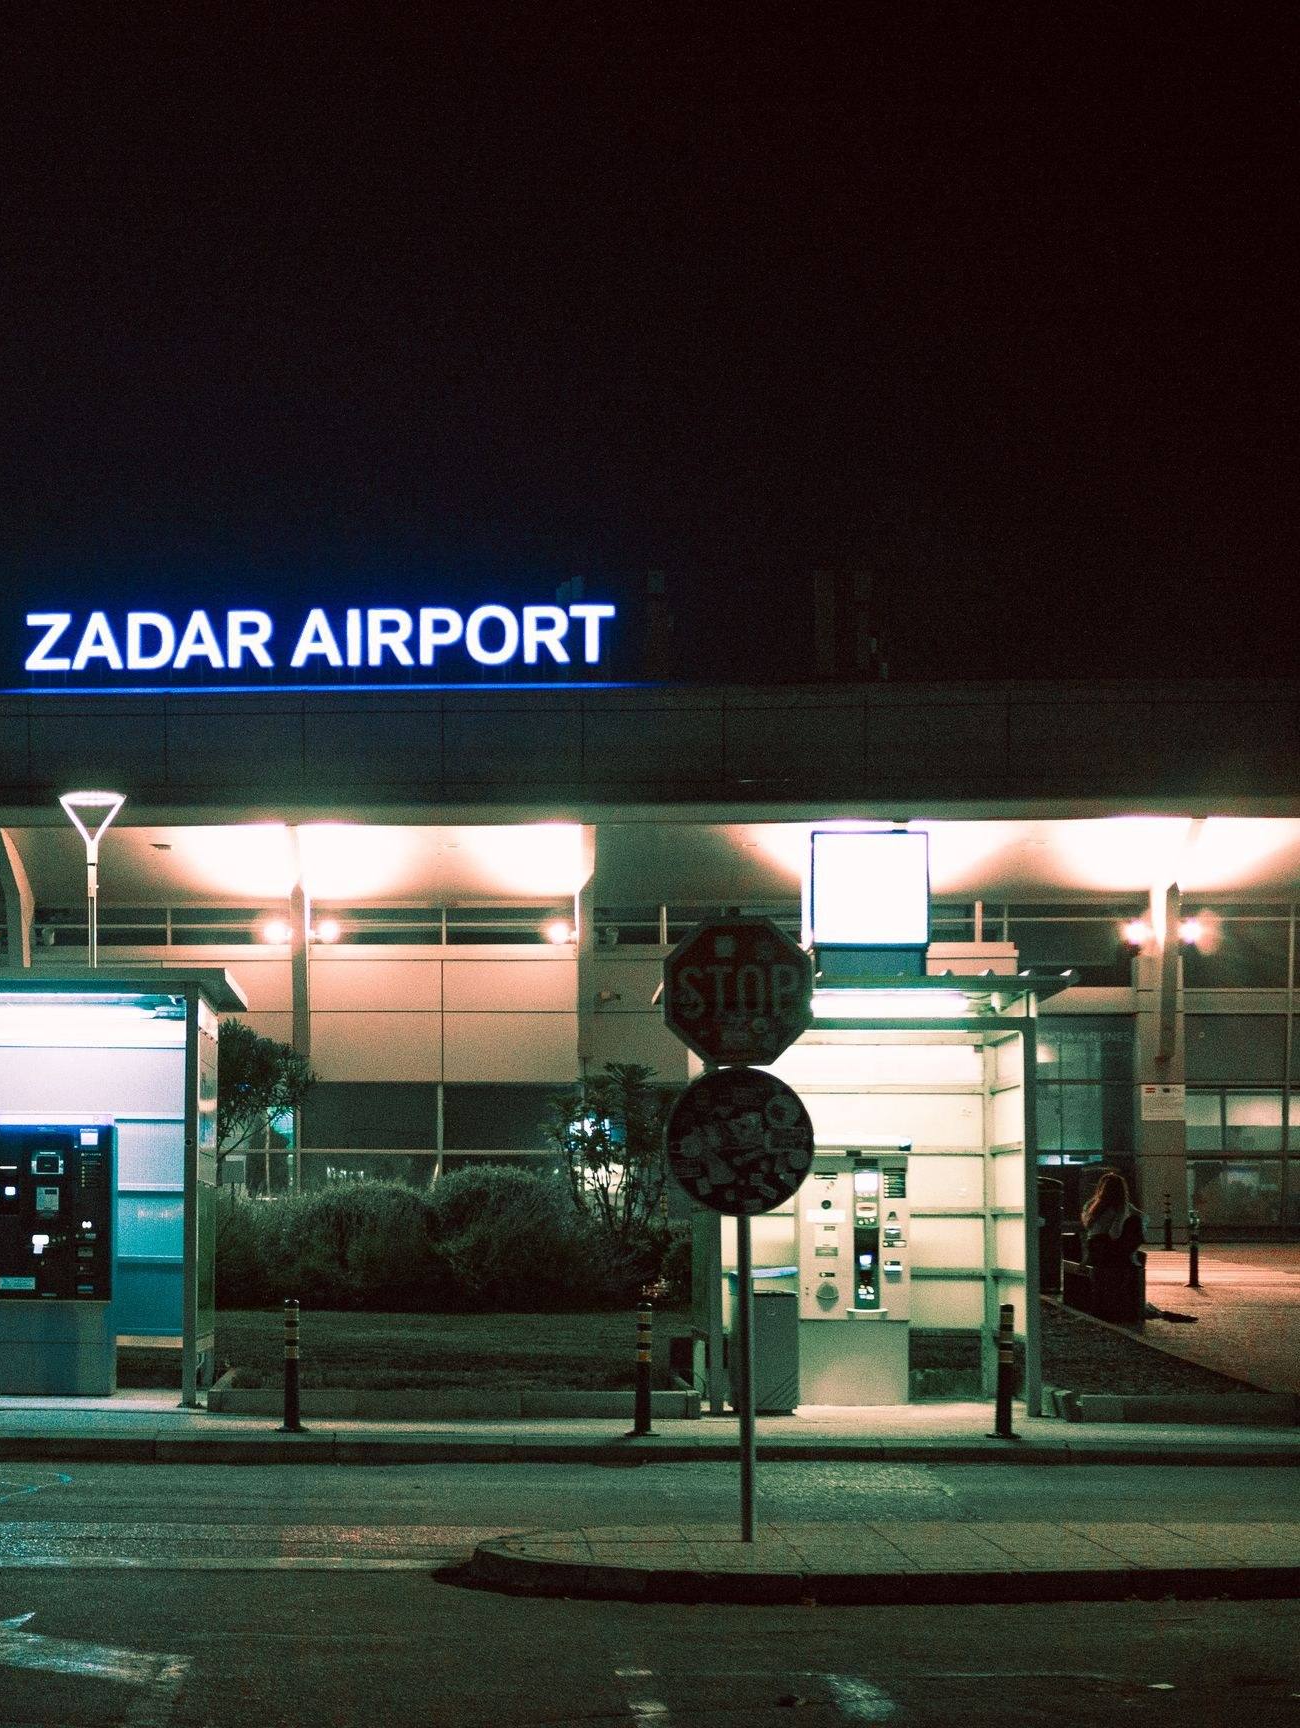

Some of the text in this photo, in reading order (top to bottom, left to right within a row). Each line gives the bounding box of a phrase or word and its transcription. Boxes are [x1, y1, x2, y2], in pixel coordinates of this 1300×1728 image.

[24, 604, 616, 671] ZADAR AIRPORT
[676, 962, 800, 1019] STOP
